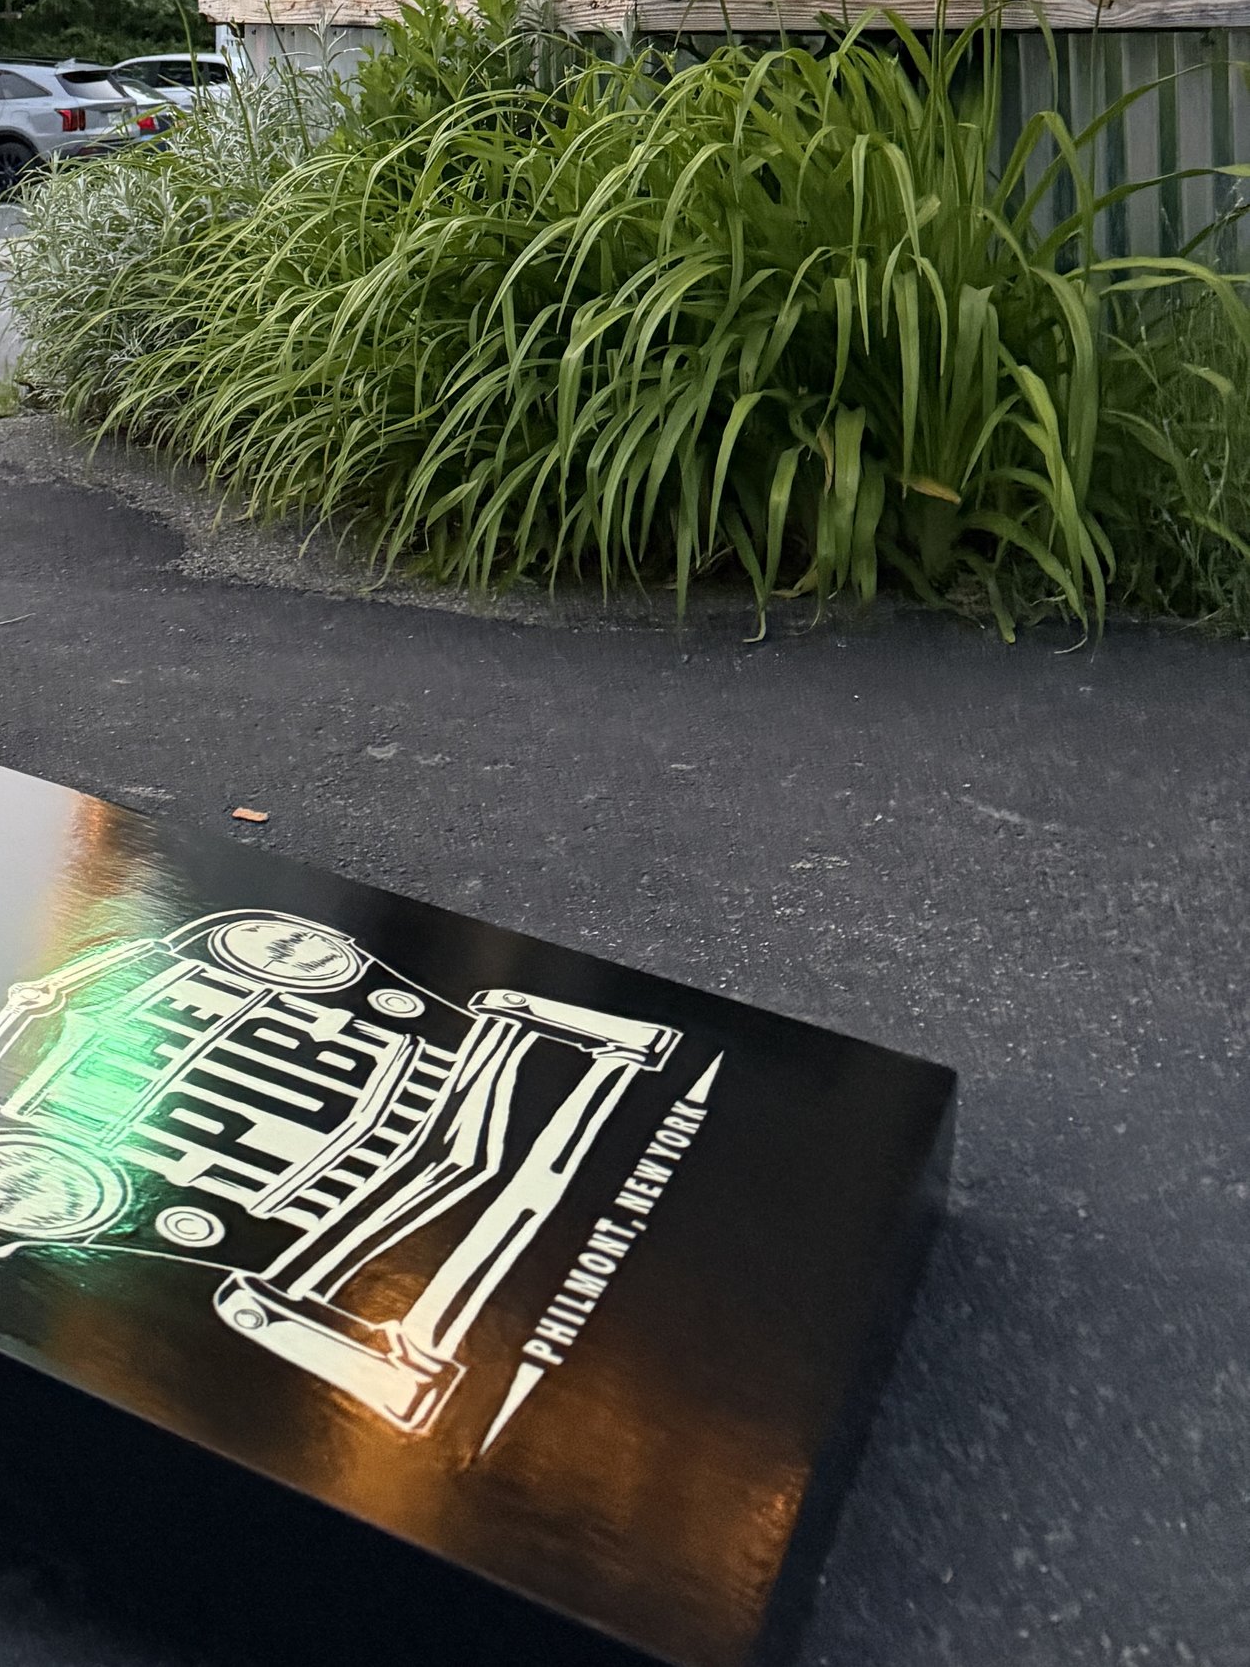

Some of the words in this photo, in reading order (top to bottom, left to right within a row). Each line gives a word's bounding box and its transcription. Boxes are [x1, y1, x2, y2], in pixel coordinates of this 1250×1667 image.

[68, 995, 225, 1093] THE
[141, 1016, 378, 1176] PUB
[521, 1217, 648, 1366] PHILMONT,
[614, 1158, 674, 1215] NEW
[645, 1100, 708, 1161] YORK
